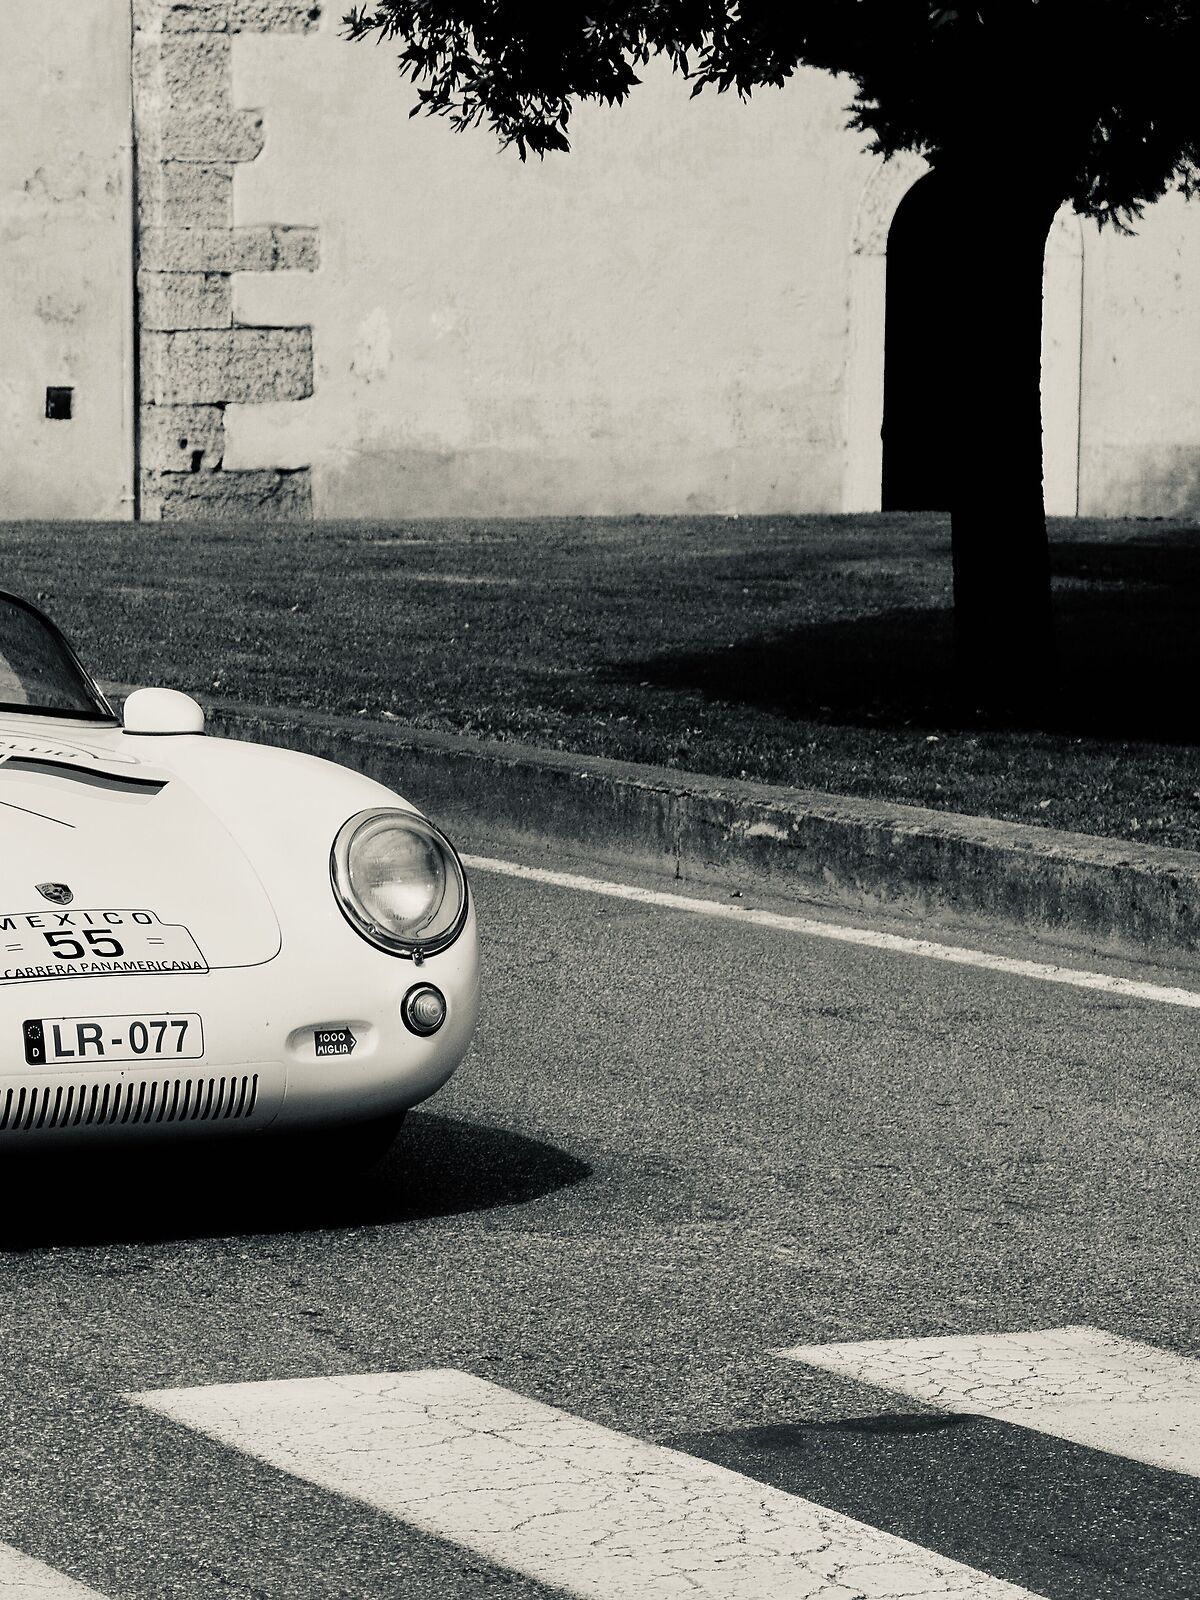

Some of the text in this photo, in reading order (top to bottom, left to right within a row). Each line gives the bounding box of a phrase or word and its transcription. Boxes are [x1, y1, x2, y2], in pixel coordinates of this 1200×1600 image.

[43, 929, 125, 960] 55
[4, 964, 77, 979] CARRERA
[80, 960, 203, 973] PANAMERICANA
[32, 1020, 189, 1058] D LR-077
[319, 1032, 346, 1042] 1000
[317, 1044, 349, 1055] MIGLIA
